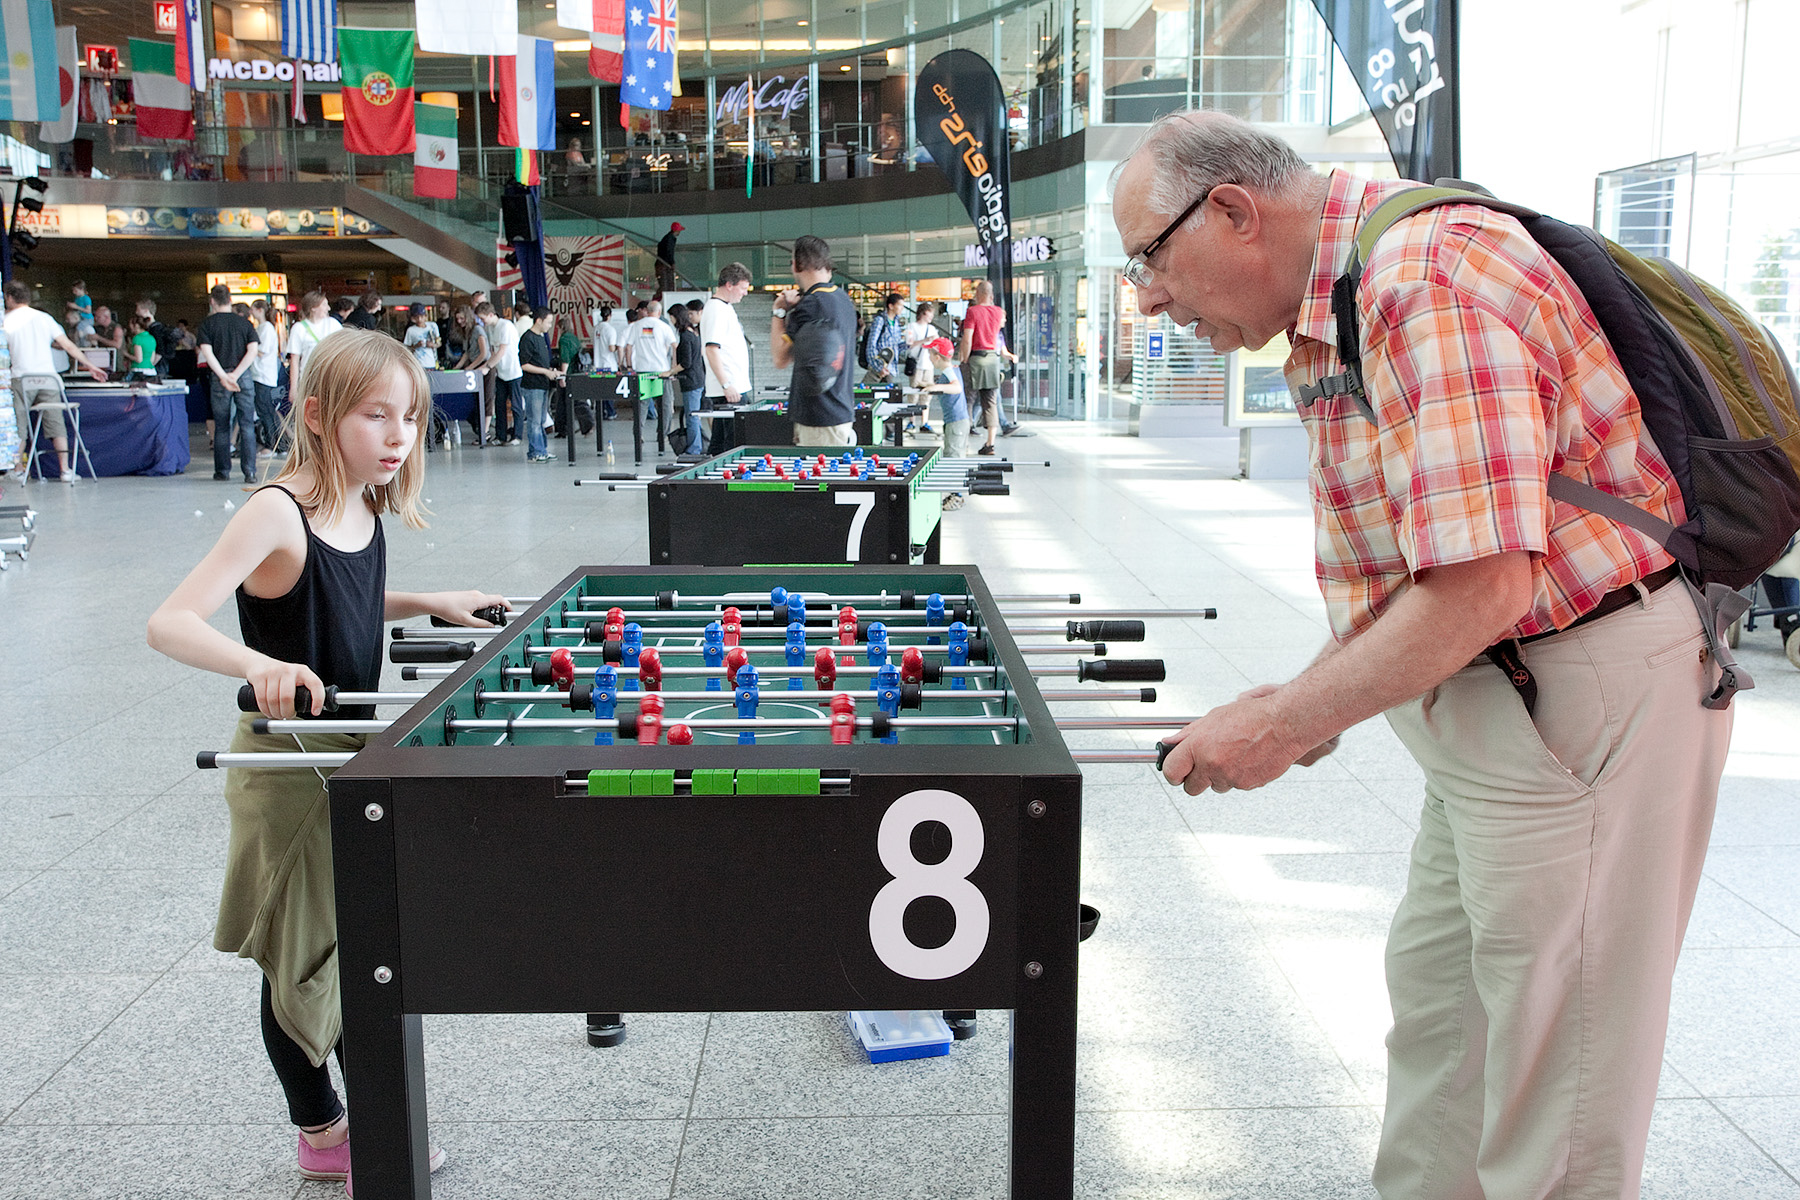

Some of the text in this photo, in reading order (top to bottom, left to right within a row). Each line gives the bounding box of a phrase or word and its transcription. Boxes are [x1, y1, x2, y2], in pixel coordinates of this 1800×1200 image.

[160, 3, 178, 28] ki
[209, 58, 341, 82] McDonal
[716, 75, 808, 124] McCafé
[465, 370, 476, 391] 3
[615, 375, 631, 398] 4
[834, 491, 876, 562] 7
[868, 788, 991, 981] 8
